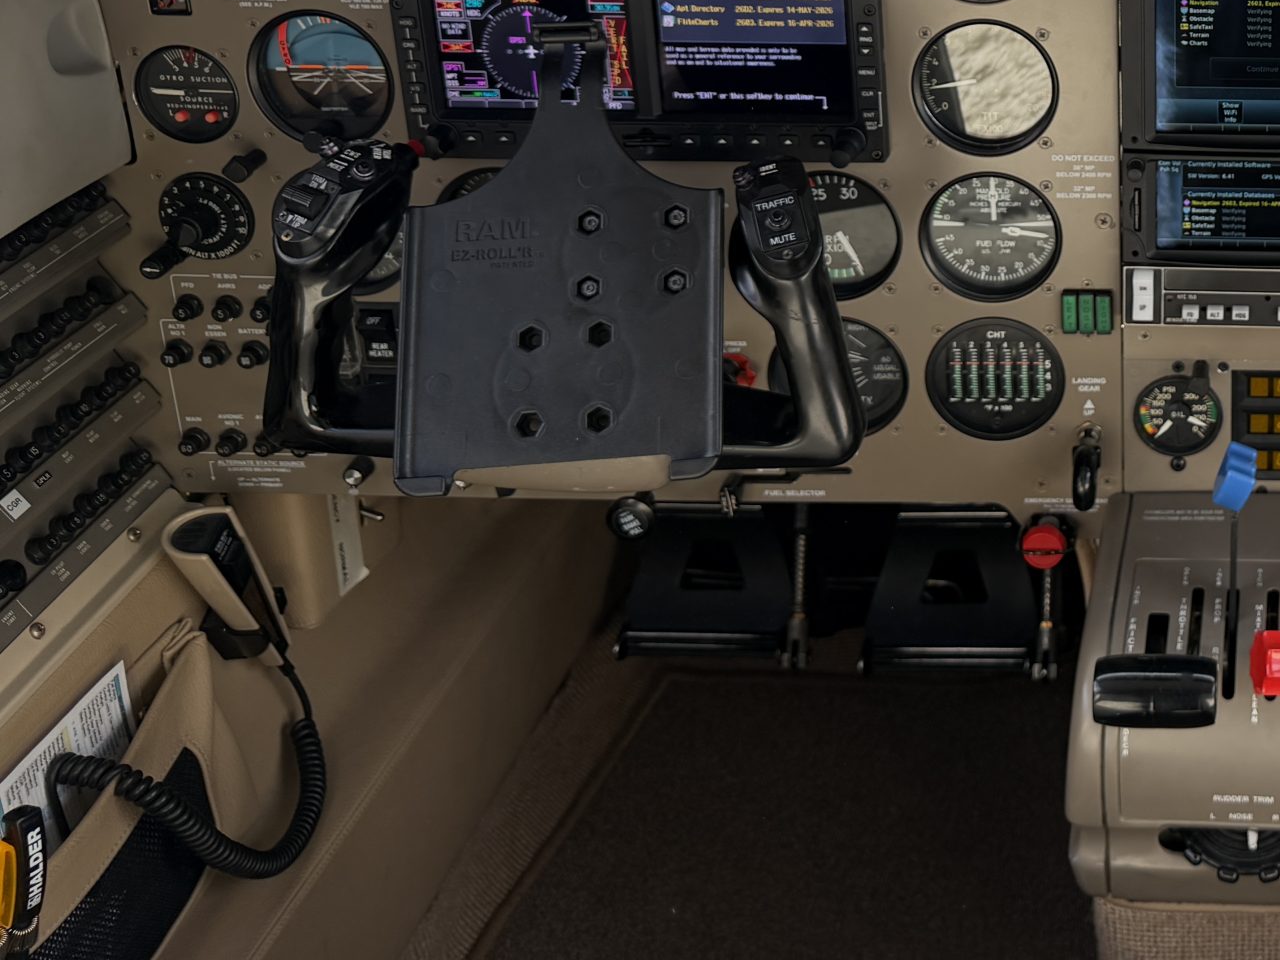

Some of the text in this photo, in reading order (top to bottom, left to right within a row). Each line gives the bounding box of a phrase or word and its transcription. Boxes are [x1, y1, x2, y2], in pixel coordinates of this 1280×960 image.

[677, 19, 718, 27] FliteCharts
[1246, 65, 1279, 73] Continue
[674, 92, 694, 100] Press
[730, 92, 745, 100] this
[746, 92, 774, 101] softkey
[1188, 161, 1216, 169] Currently
[756, 196, 794, 211] TRAFFIC
[455, 218, 528, 243] RAM
[770, 233, 796, 246] MUTE
[451, 246, 533, 262] EZ-ROLL'R
[371, 342, 388, 350] REAR
[1072, 377, 1106, 385] LANDING
[7, 498, 22, 511] CGR
